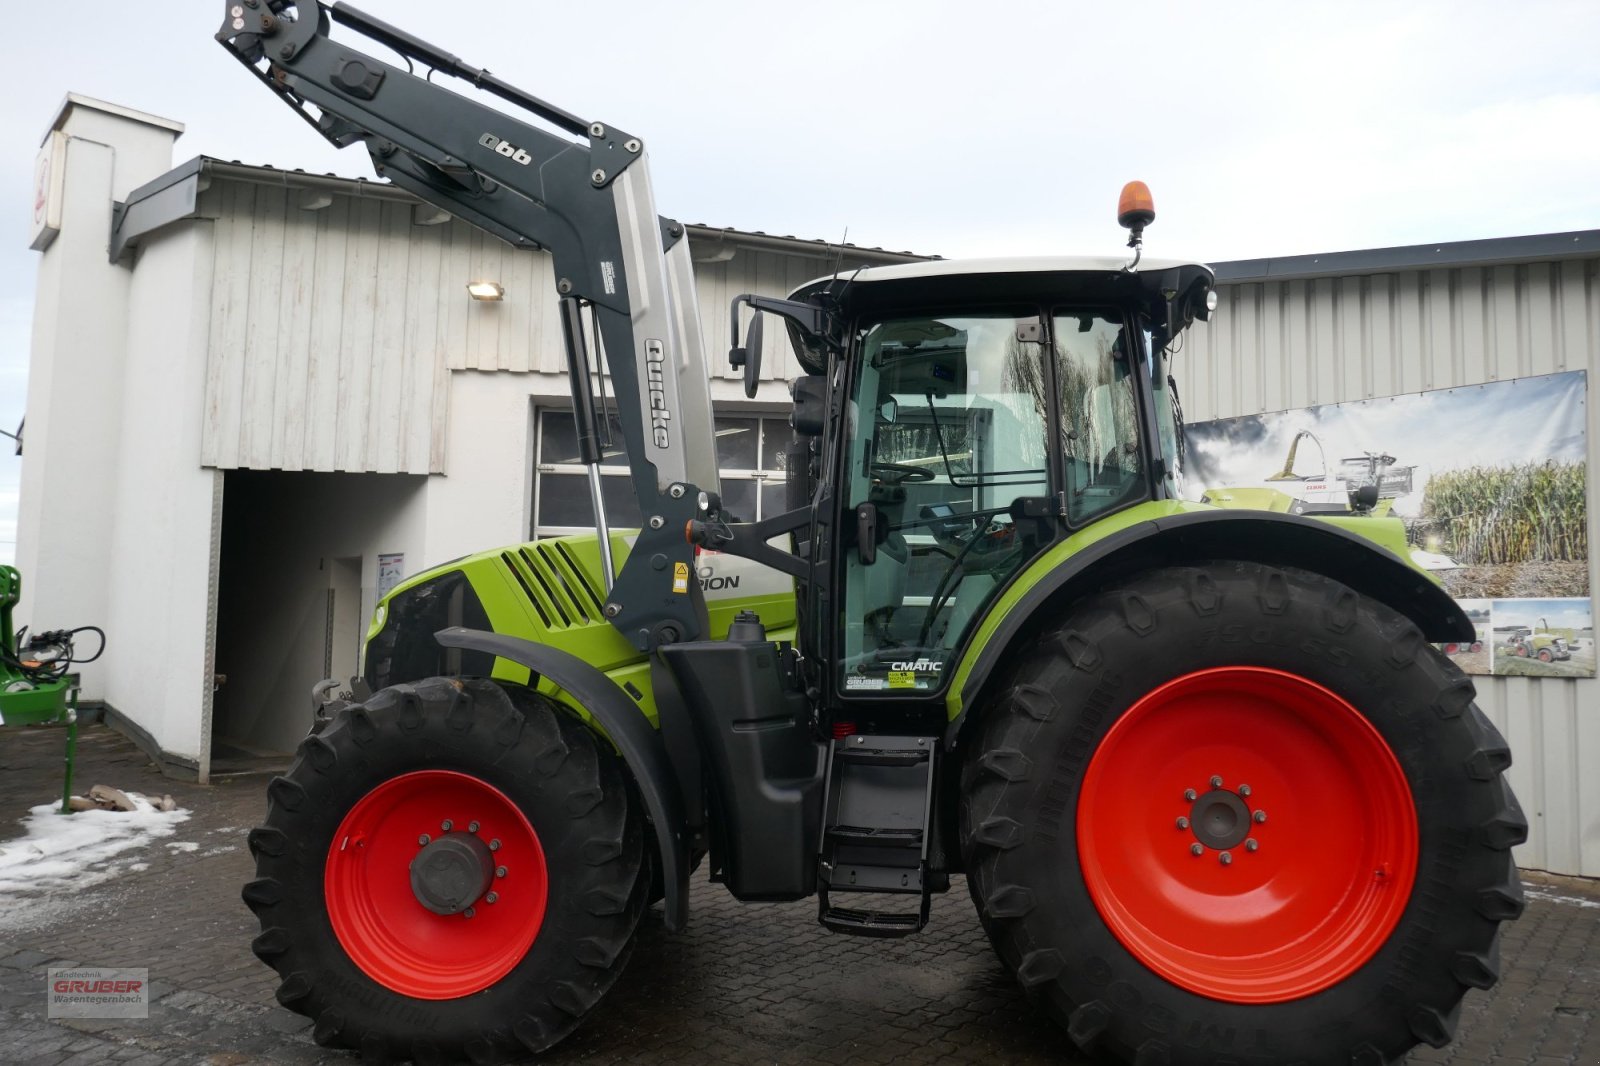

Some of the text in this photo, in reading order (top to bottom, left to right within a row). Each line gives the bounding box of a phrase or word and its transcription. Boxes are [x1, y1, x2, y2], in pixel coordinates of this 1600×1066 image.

[478, 132, 532, 166] Q66
[699, 575, 740, 592] ION
[891, 659, 943, 671] CMATIC
